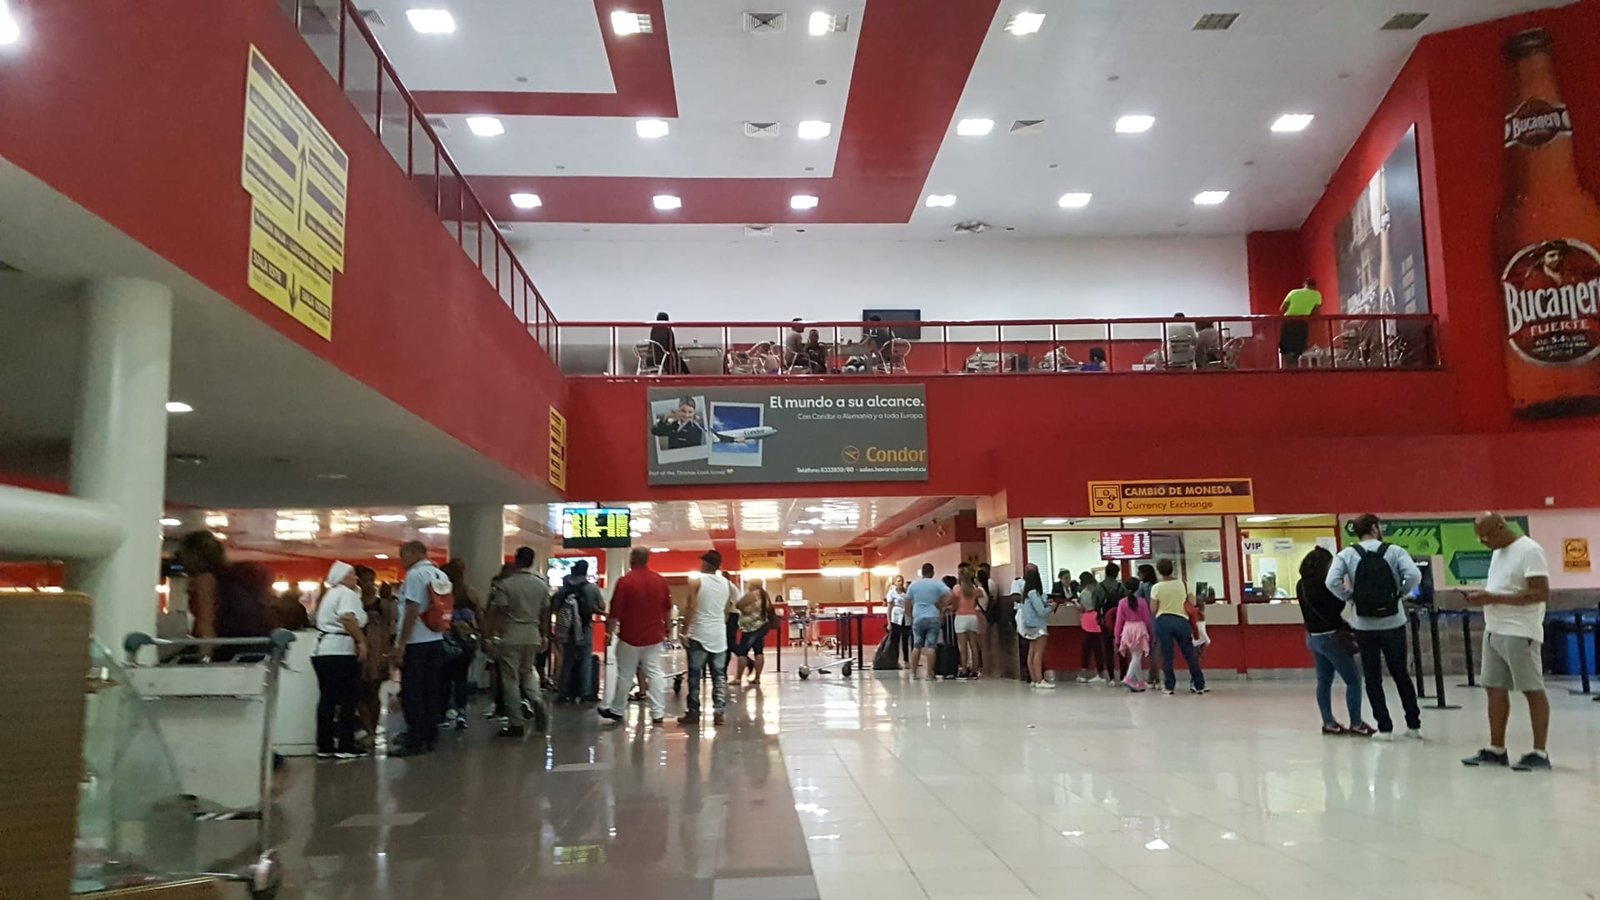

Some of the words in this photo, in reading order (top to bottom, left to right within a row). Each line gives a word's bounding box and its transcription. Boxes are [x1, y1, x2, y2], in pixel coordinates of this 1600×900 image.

[1512, 111, 1561, 138] Bucanero
[1530, 319, 1590, 337] FUERTE
[769, 396, 783, 408] El
[785, 395, 833, 408] mundo
[836, 398, 845, 407] a
[848, 398, 864, 407] su
[866, 395, 925, 407] alcance.
[812, 412, 836, 420] Condor
[842, 412, 872, 420] Alemania
[866, 446, 926, 463] Condor
[1124, 486, 1166, 496] CAMBIO
[1169, 486, 1182, 495] DE
[1185, 485, 1232, 495] MONEDA
[1126, 501, 1167, 511] Currency
[1170, 500, 1213, 510] Exchange
[1244, 542, 1262, 550] VIP
